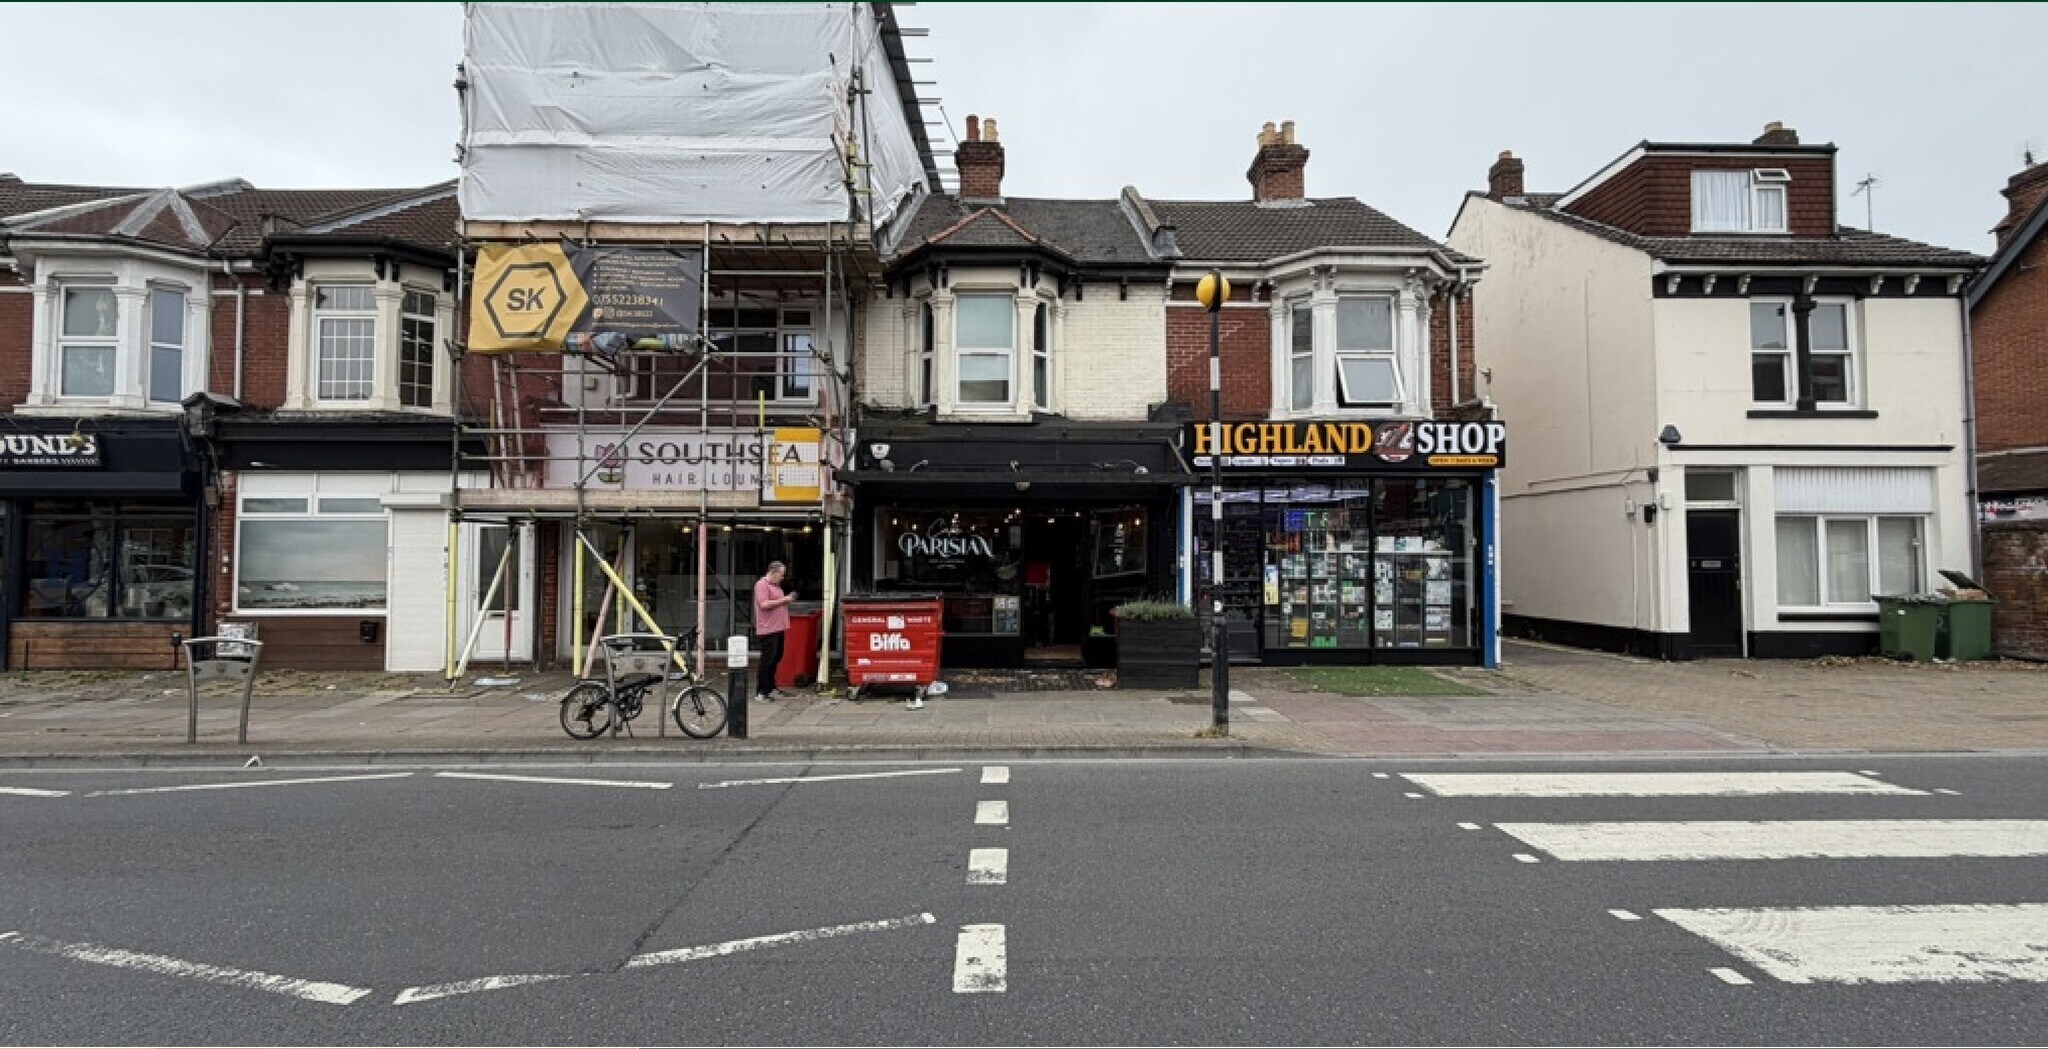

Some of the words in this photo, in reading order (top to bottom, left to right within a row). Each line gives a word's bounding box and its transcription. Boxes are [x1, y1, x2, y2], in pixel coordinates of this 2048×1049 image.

[506, 286, 546, 311] SK
[1194, 423, 1373, 454] HIGHLAND
[1417, 422, 1506, 454] SHOP
[638, 442, 801, 466] SOUTHSEA
[653, 474, 697, 485] HAIR
[899, 533, 993, 558] PARISIAN
[870, 632, 911, 651] Biffa
